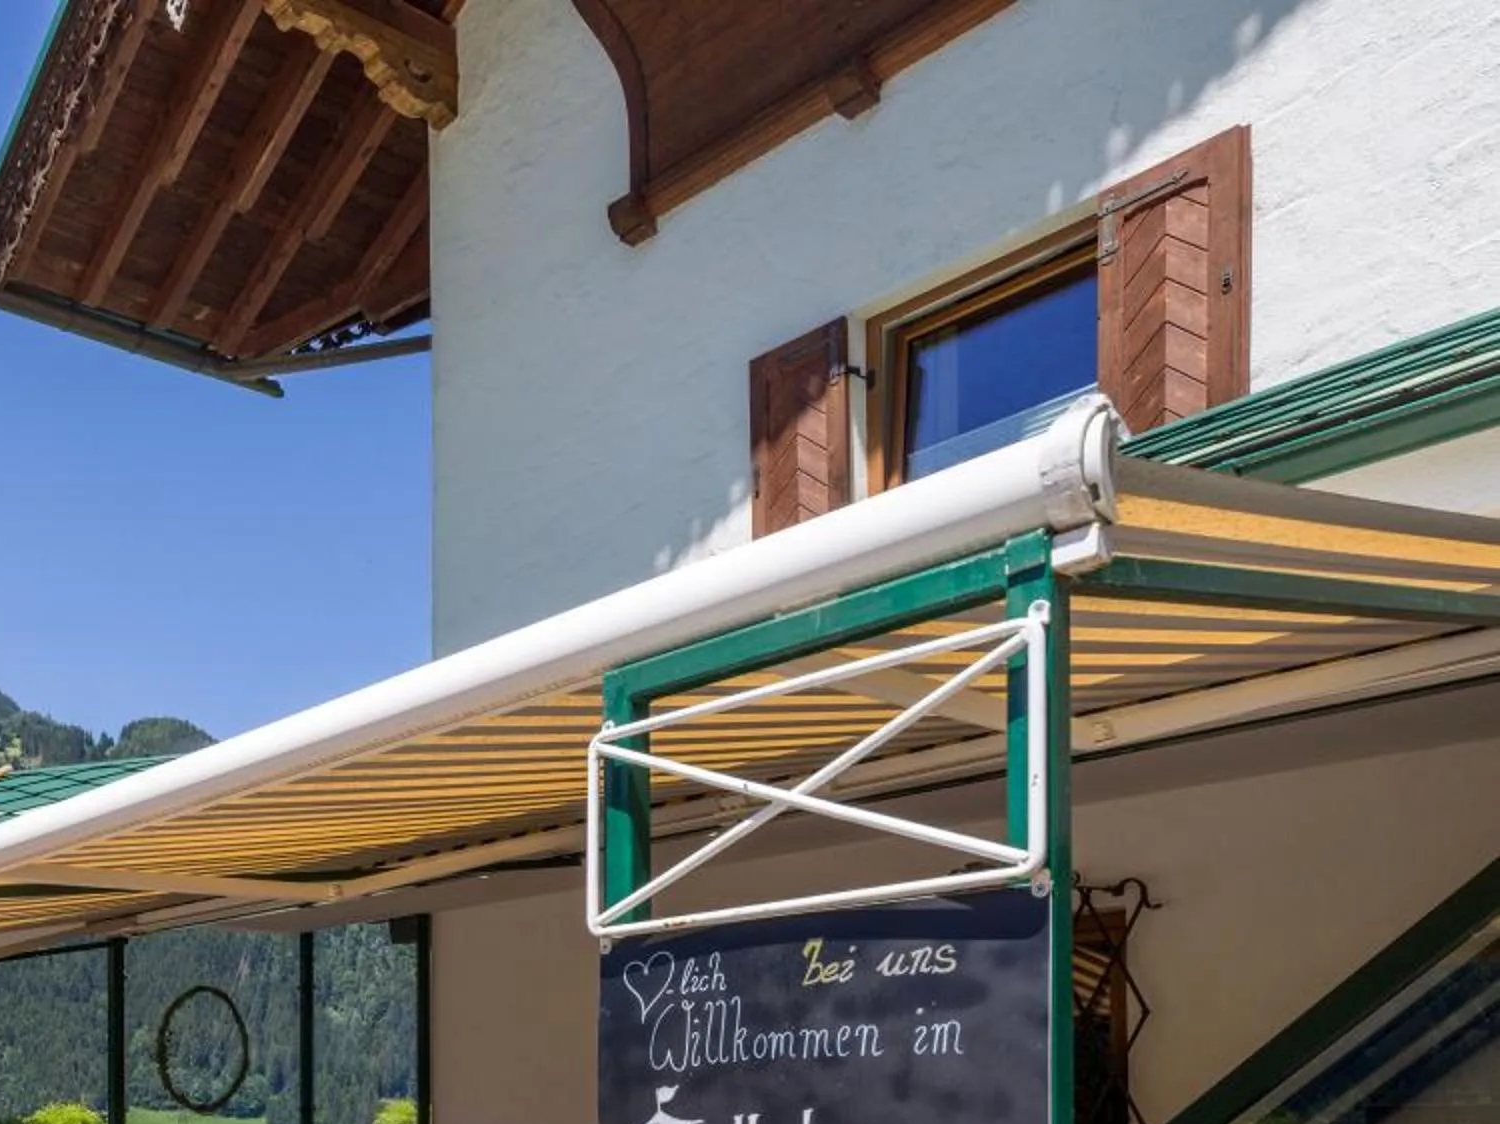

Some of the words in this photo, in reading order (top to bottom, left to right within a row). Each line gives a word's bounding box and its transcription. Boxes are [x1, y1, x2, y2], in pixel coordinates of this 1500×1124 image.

[876, 944, 958, 978] uns
[649, 995, 885, 1073] Willkommen
[913, 1006, 965, 1056] im
